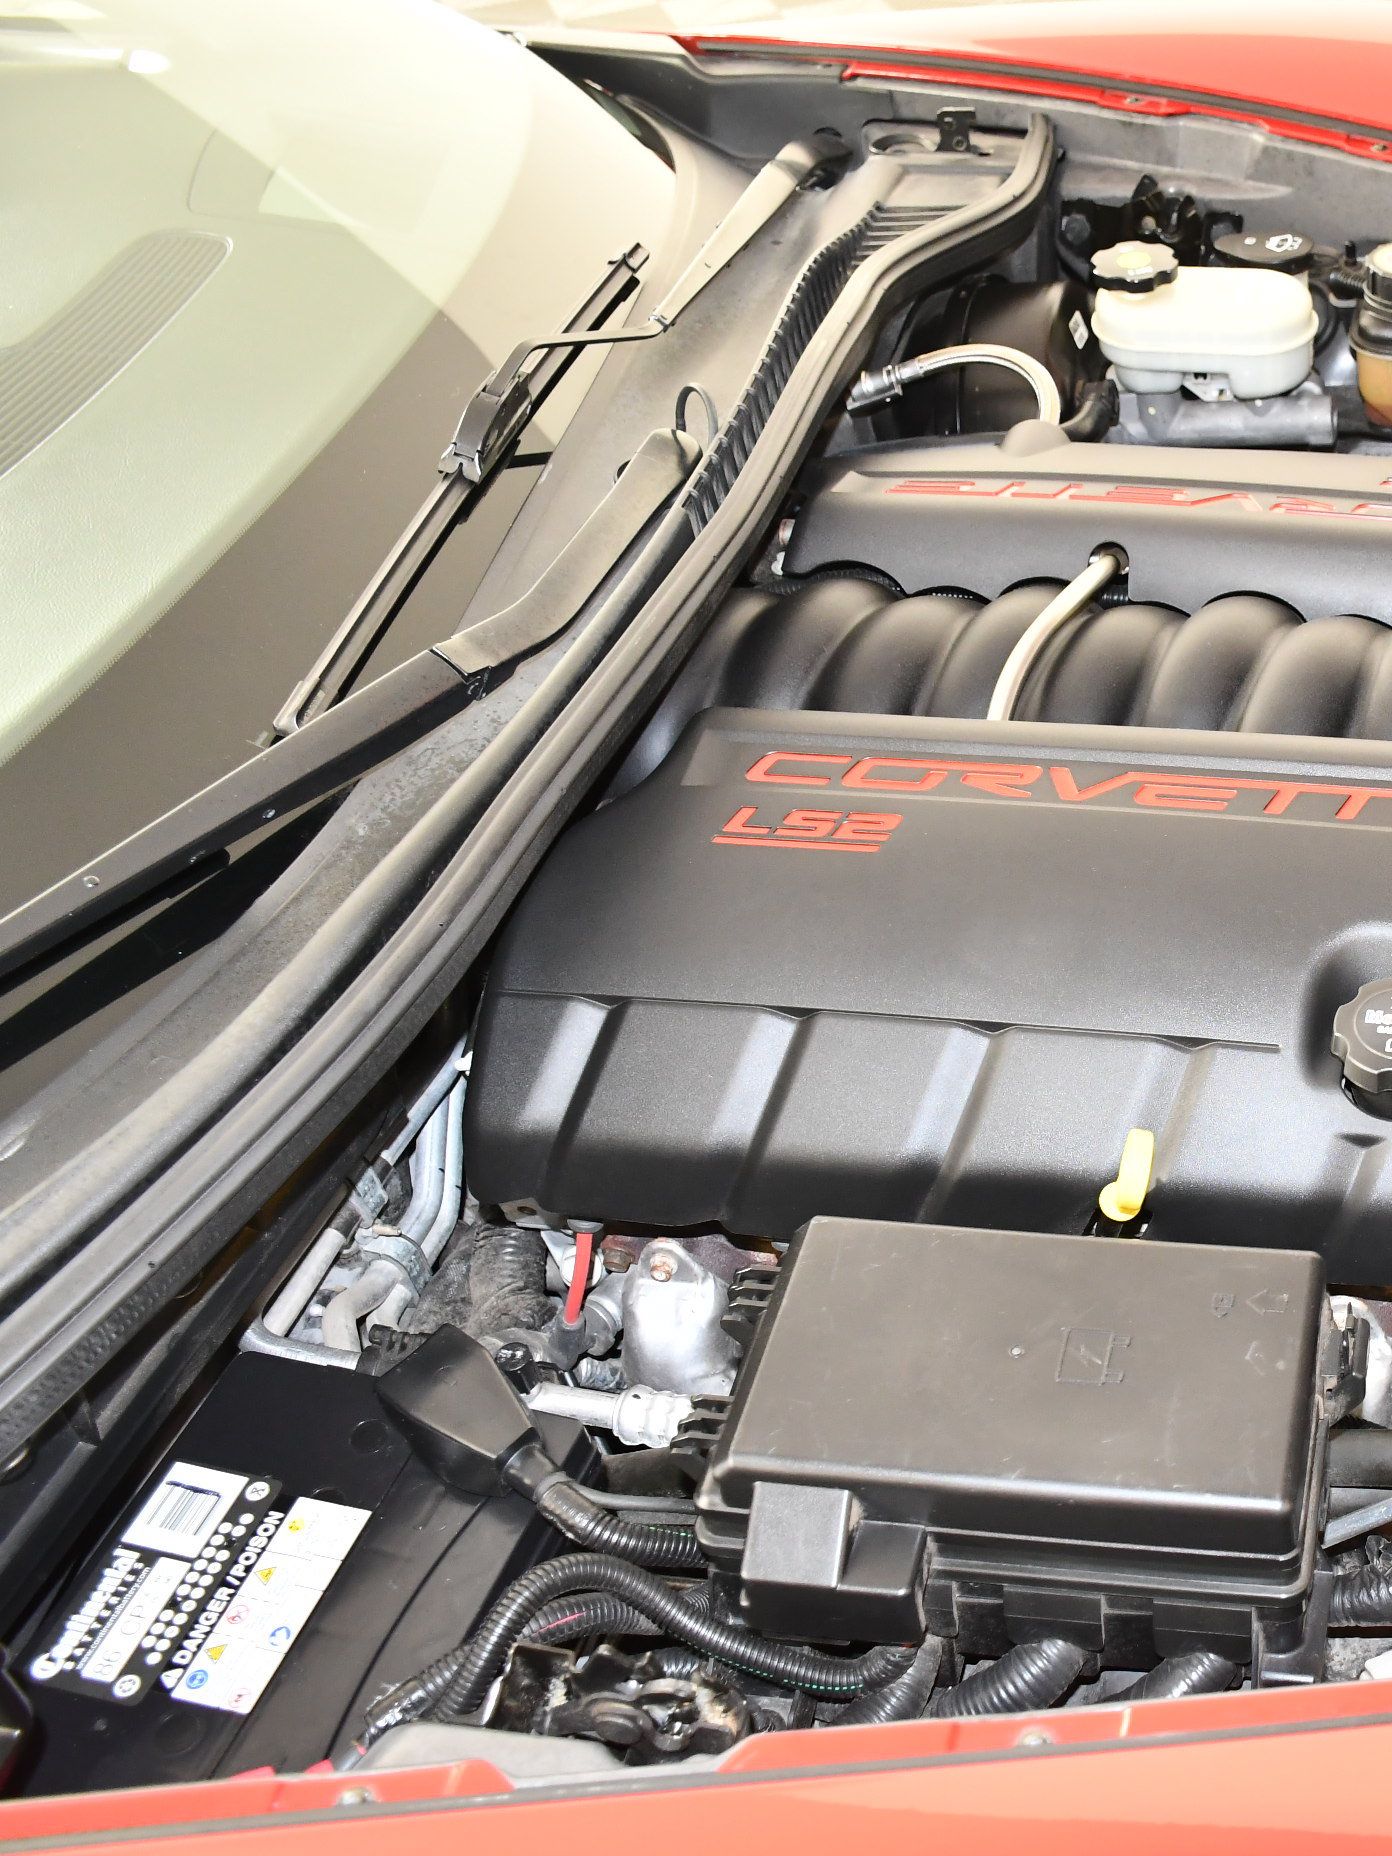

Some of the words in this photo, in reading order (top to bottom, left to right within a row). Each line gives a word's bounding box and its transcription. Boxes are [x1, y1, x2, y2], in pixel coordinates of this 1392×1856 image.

[722, 805, 904, 841] LS2
[63, 1561, 144, 1671] BATTERIES
[172, 1585, 235, 1665] DANGER
